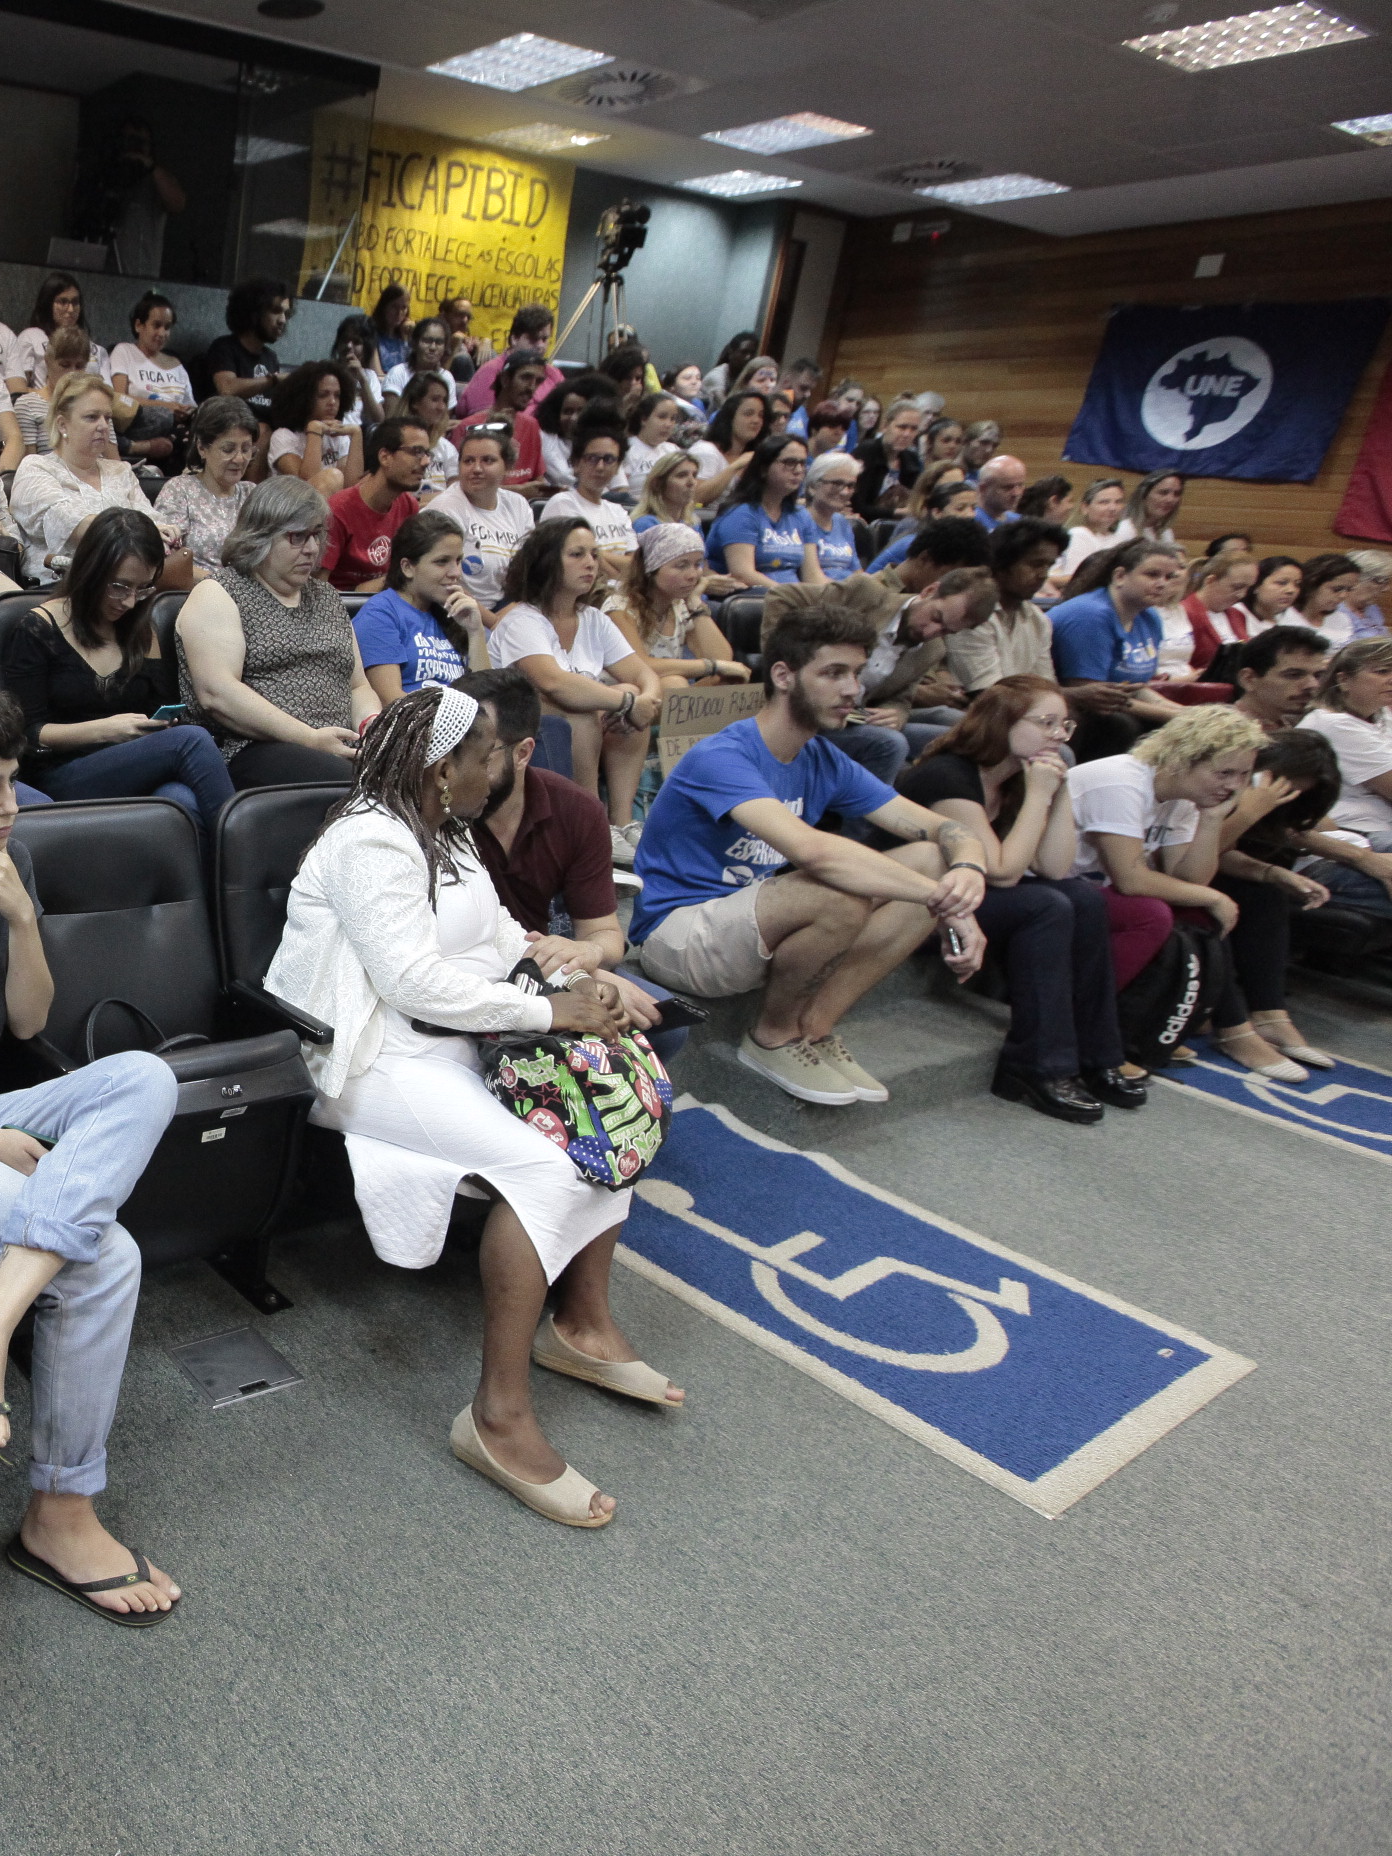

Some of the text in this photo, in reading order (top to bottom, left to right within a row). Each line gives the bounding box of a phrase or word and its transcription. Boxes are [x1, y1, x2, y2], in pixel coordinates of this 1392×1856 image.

[386, 223, 475, 269] FORTALECE
[494, 246, 562, 284] ESCOLAS
[138, 369, 165, 384] FICA
[1182, 374, 1246, 397] UNE
[666, 738, 682, 757] DE
[1158, 979, 1201, 1045] adidas
